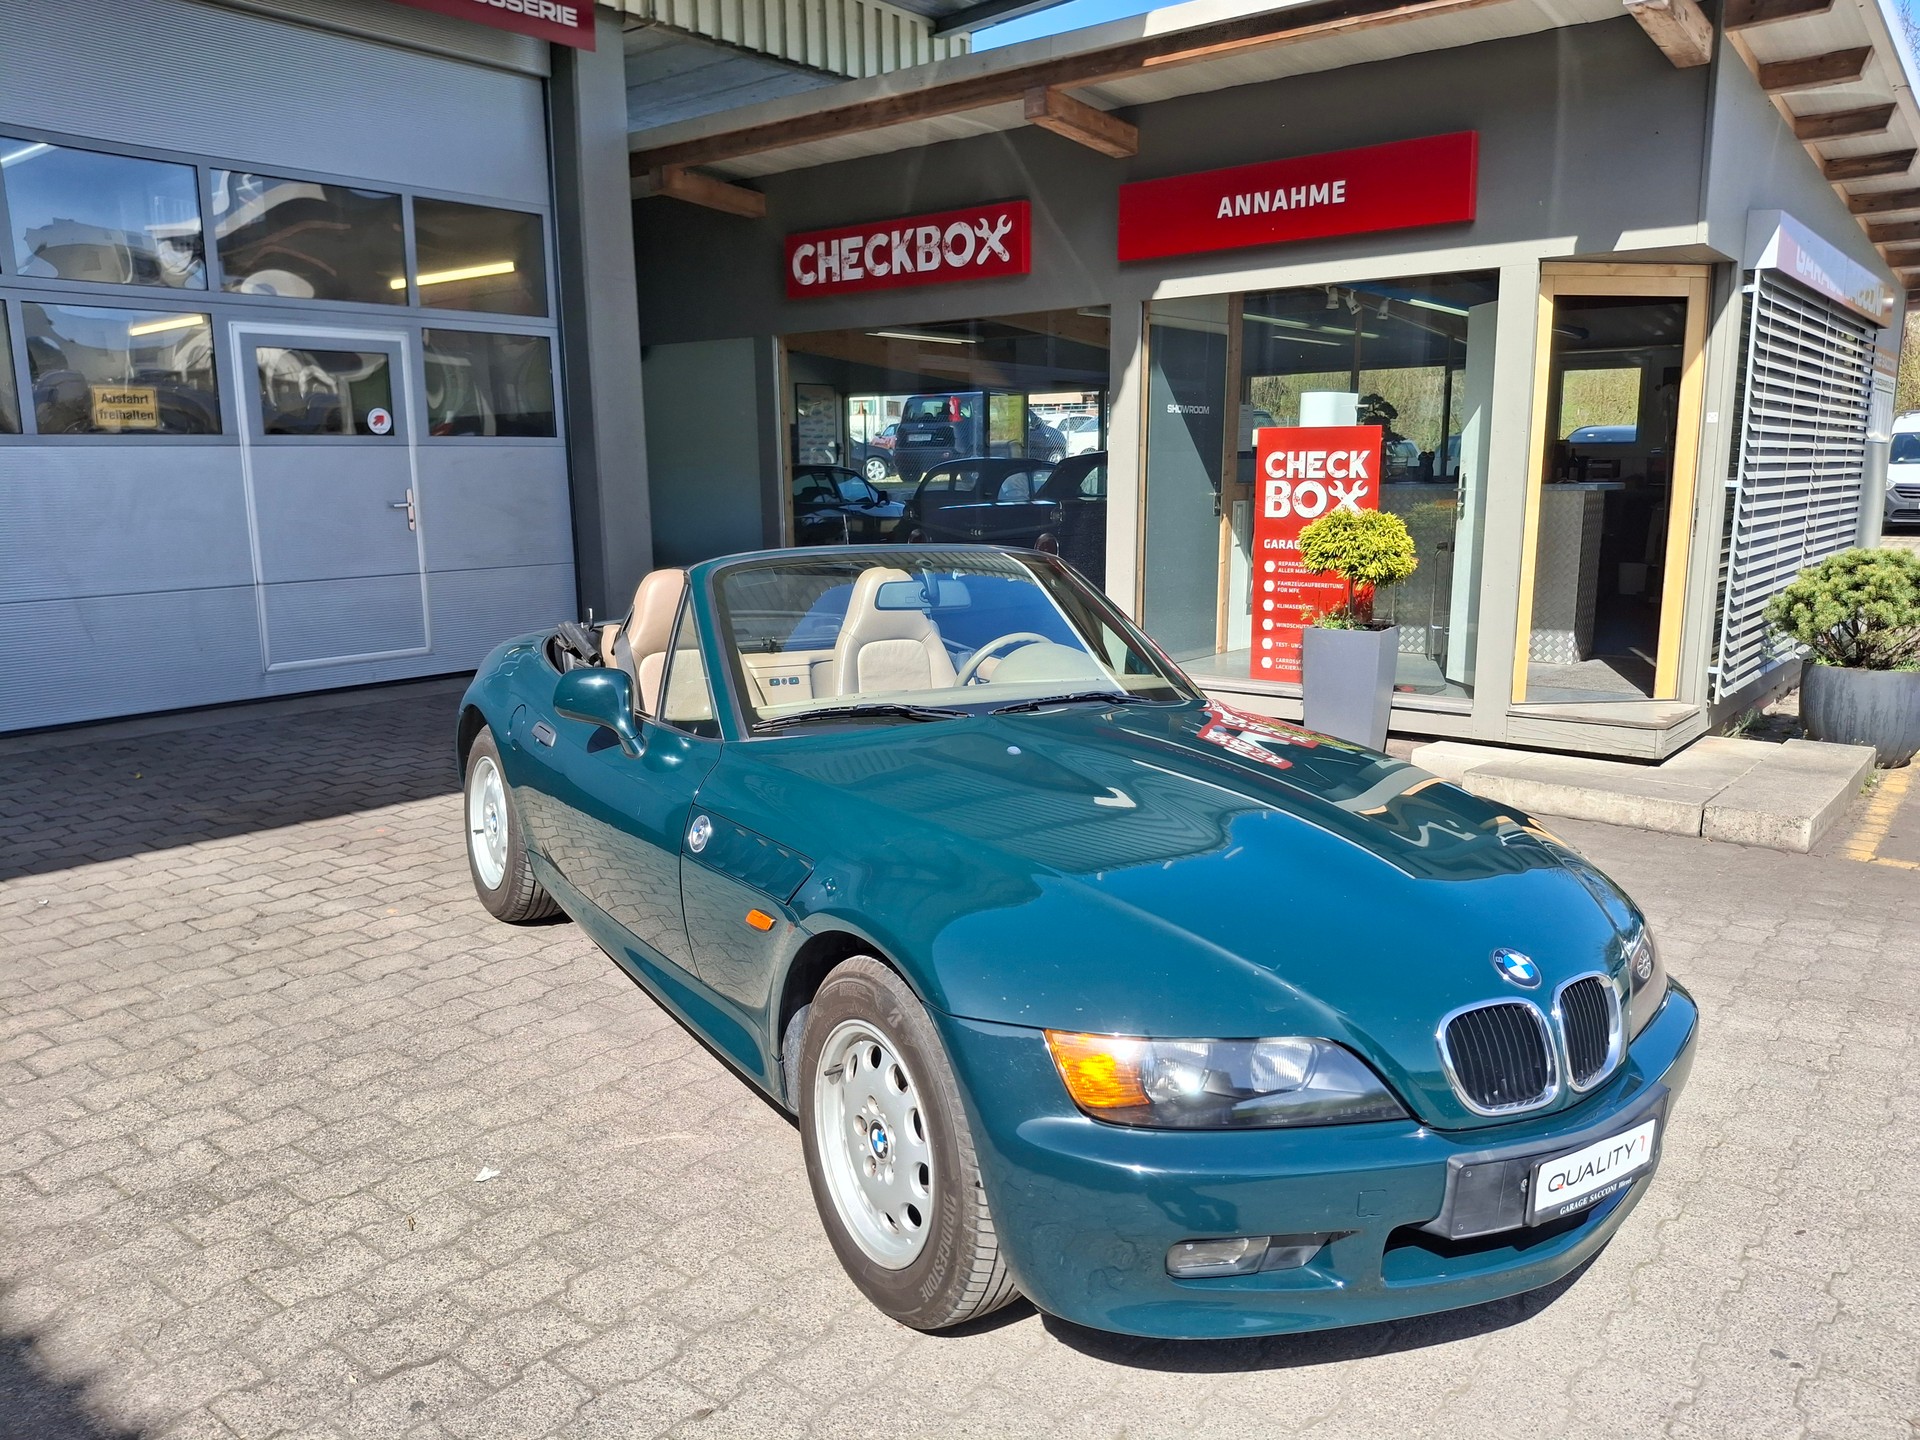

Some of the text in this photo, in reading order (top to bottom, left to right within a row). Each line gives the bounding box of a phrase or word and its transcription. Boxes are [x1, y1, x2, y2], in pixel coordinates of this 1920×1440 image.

[472, 0, 578, 28] SERIE
[1216, 180, 1347, 219] ANNAHME
[792, 214, 1013, 286] CHECKBOX
[101, 393, 149, 404] Ausfahrt
[1167, 404, 1210, 415] SHOWROOM
[98, 408, 154, 420] freihalten
[1264, 450, 1371, 479] CHECK
[1264, 480, 1369, 519] BOX
[1263, 538, 1302, 550] GARAG
[1277, 581, 1344, 589] FAHRZEUGAUFBEREITUNG
[1547, 1138, 1637, 1193] QUALITY
[1560, 1196, 1589, 1215] GARAGE
[1589, 1182, 1618, 1202] SACCONI
